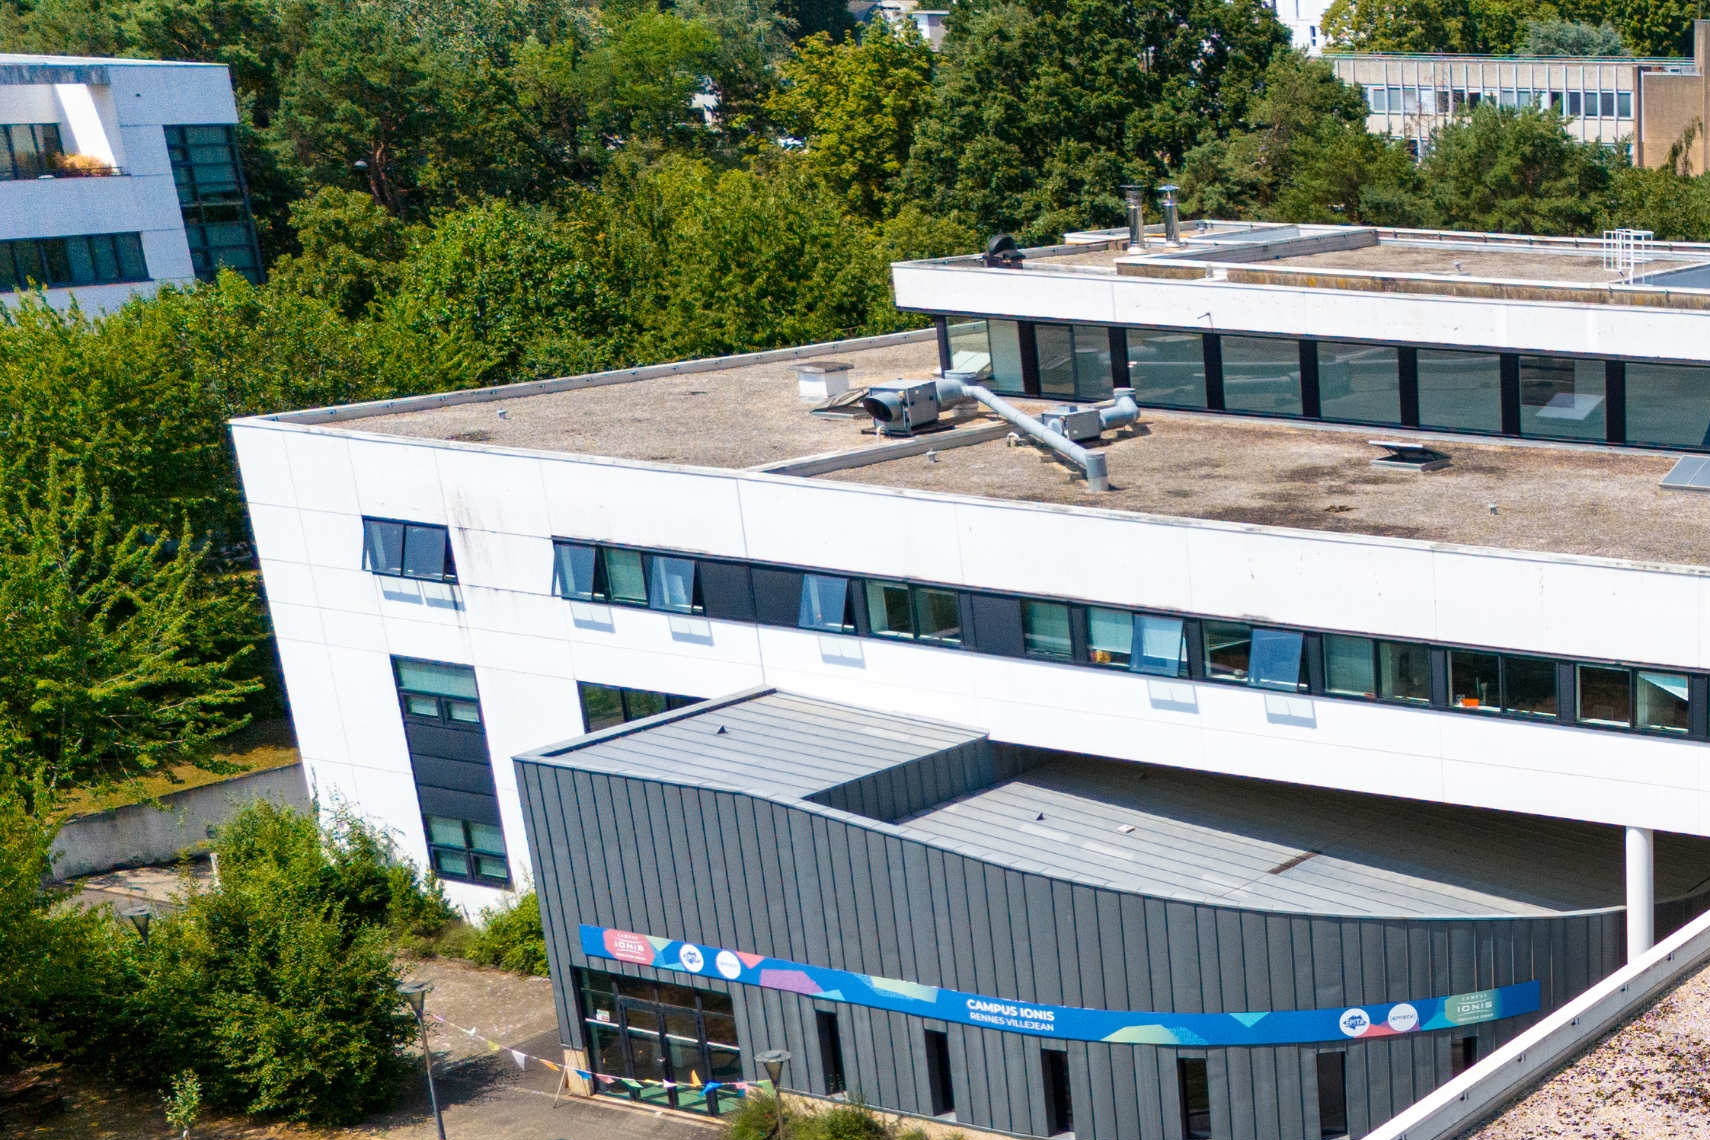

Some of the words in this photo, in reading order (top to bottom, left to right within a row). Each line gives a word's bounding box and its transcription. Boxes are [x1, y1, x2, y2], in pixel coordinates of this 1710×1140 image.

[615, 941, 644, 951] IONIS
[967, 999, 1017, 1016] CAMPUS
[1020, 1007, 1055, 1021] IONIS
[1457, 1001, 1493, 1013] IONIS
[970, 1012, 1005, 1024] RENNES
[1006, 1018, 1054, 1031] VILLEJEAN
